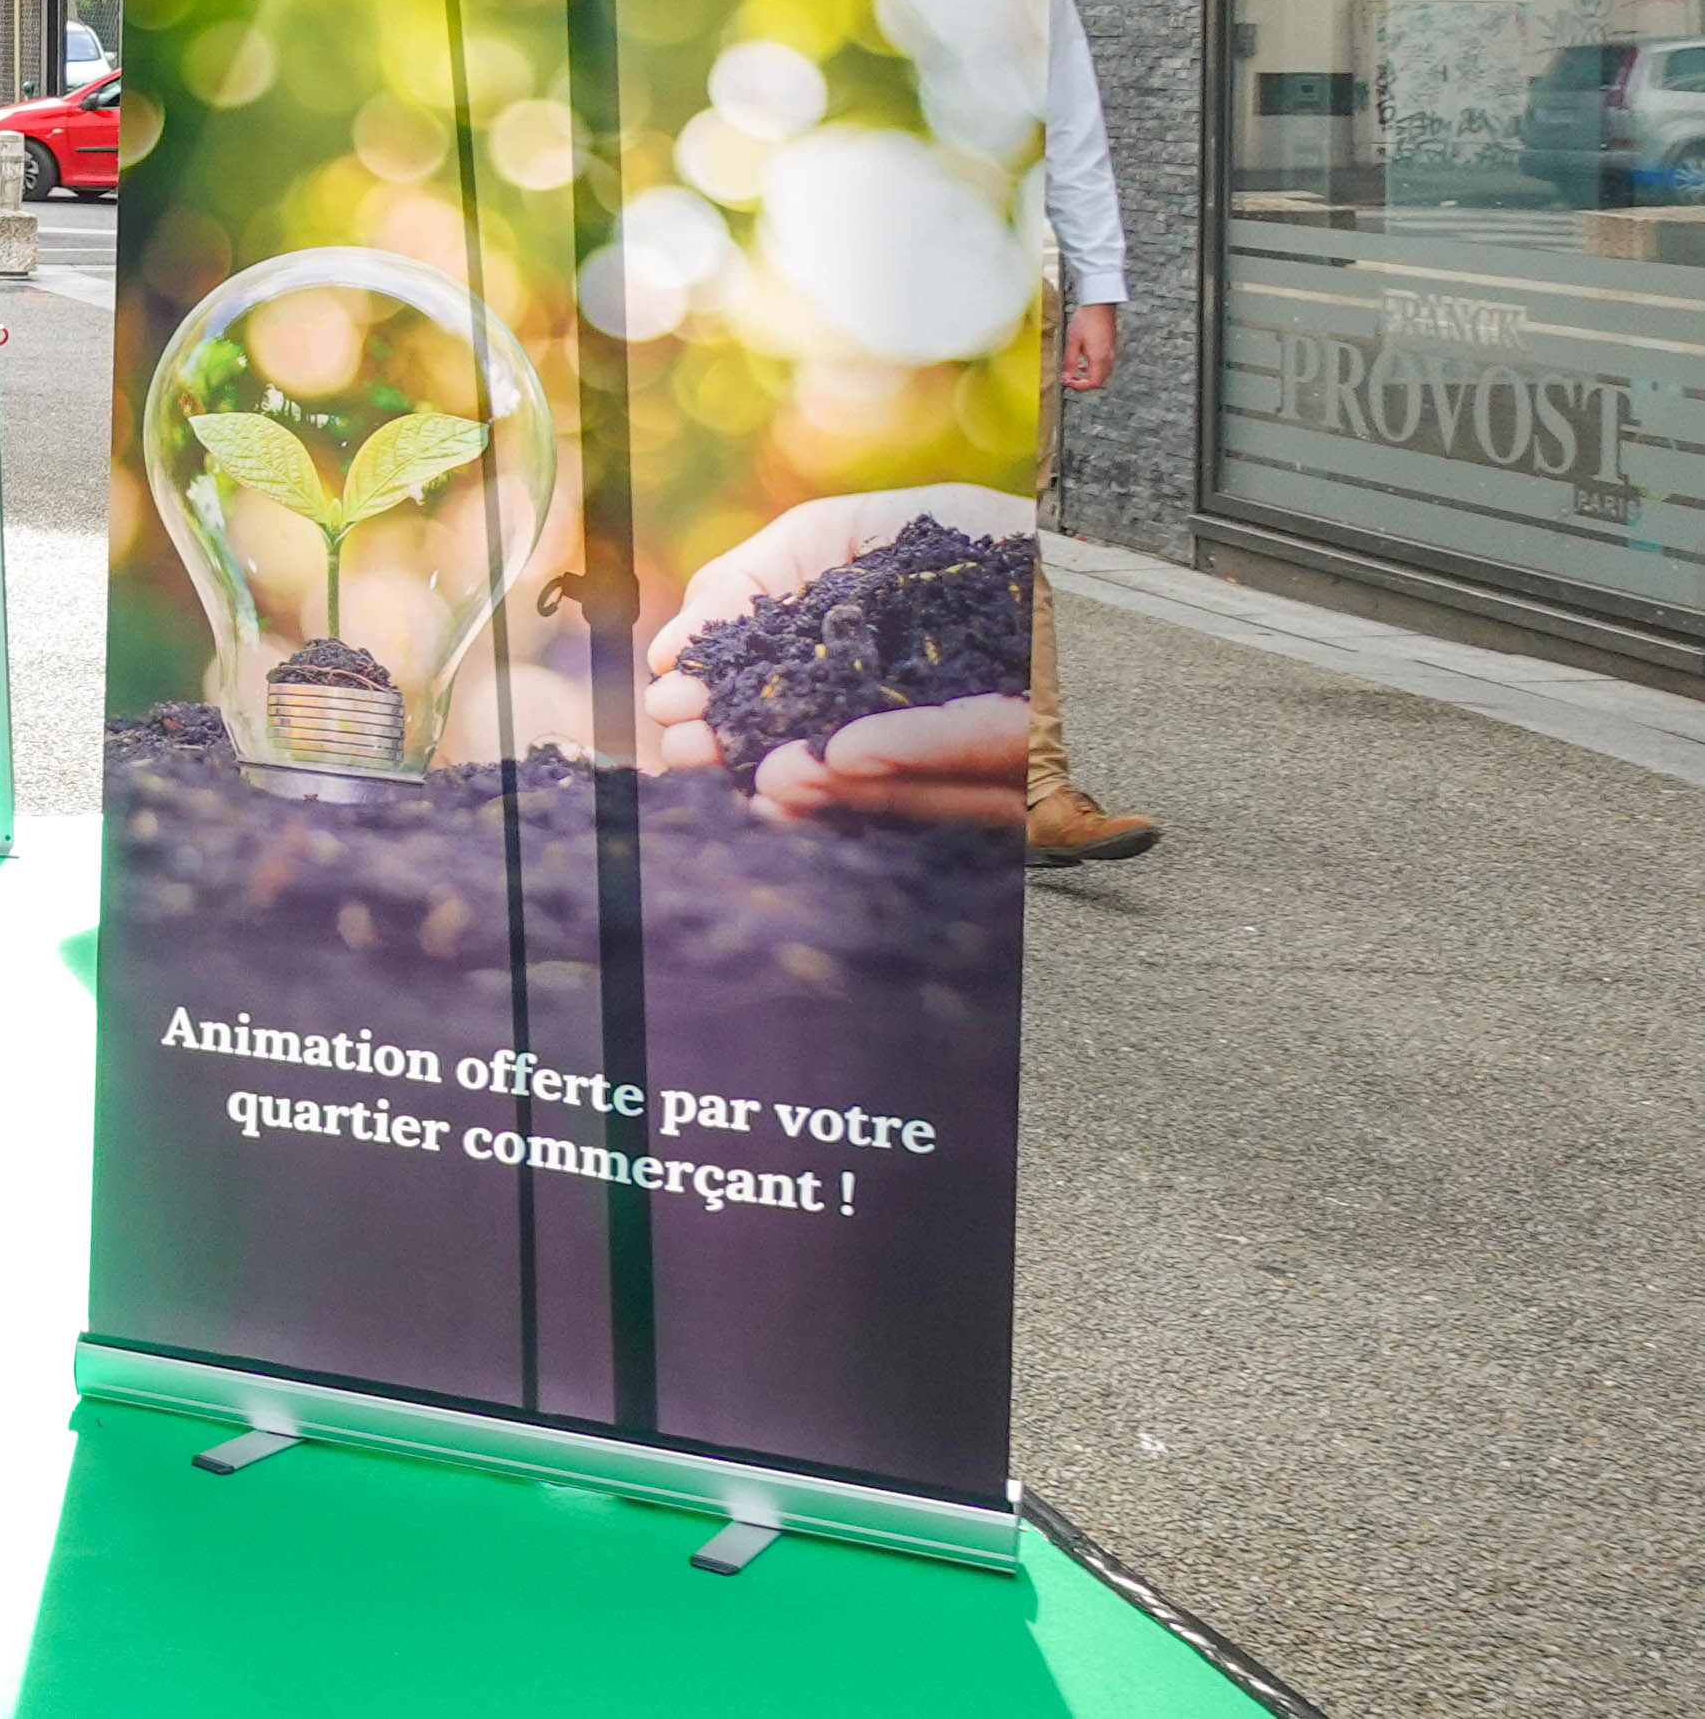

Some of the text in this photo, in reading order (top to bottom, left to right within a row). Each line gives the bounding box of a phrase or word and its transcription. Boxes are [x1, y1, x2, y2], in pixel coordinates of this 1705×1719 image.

[1279, 333, 1634, 485] PROVOST
[161, 1006, 937, 1156] Animation offerte par votre
[226, 1085, 856, 1217] quartier commerçant !
